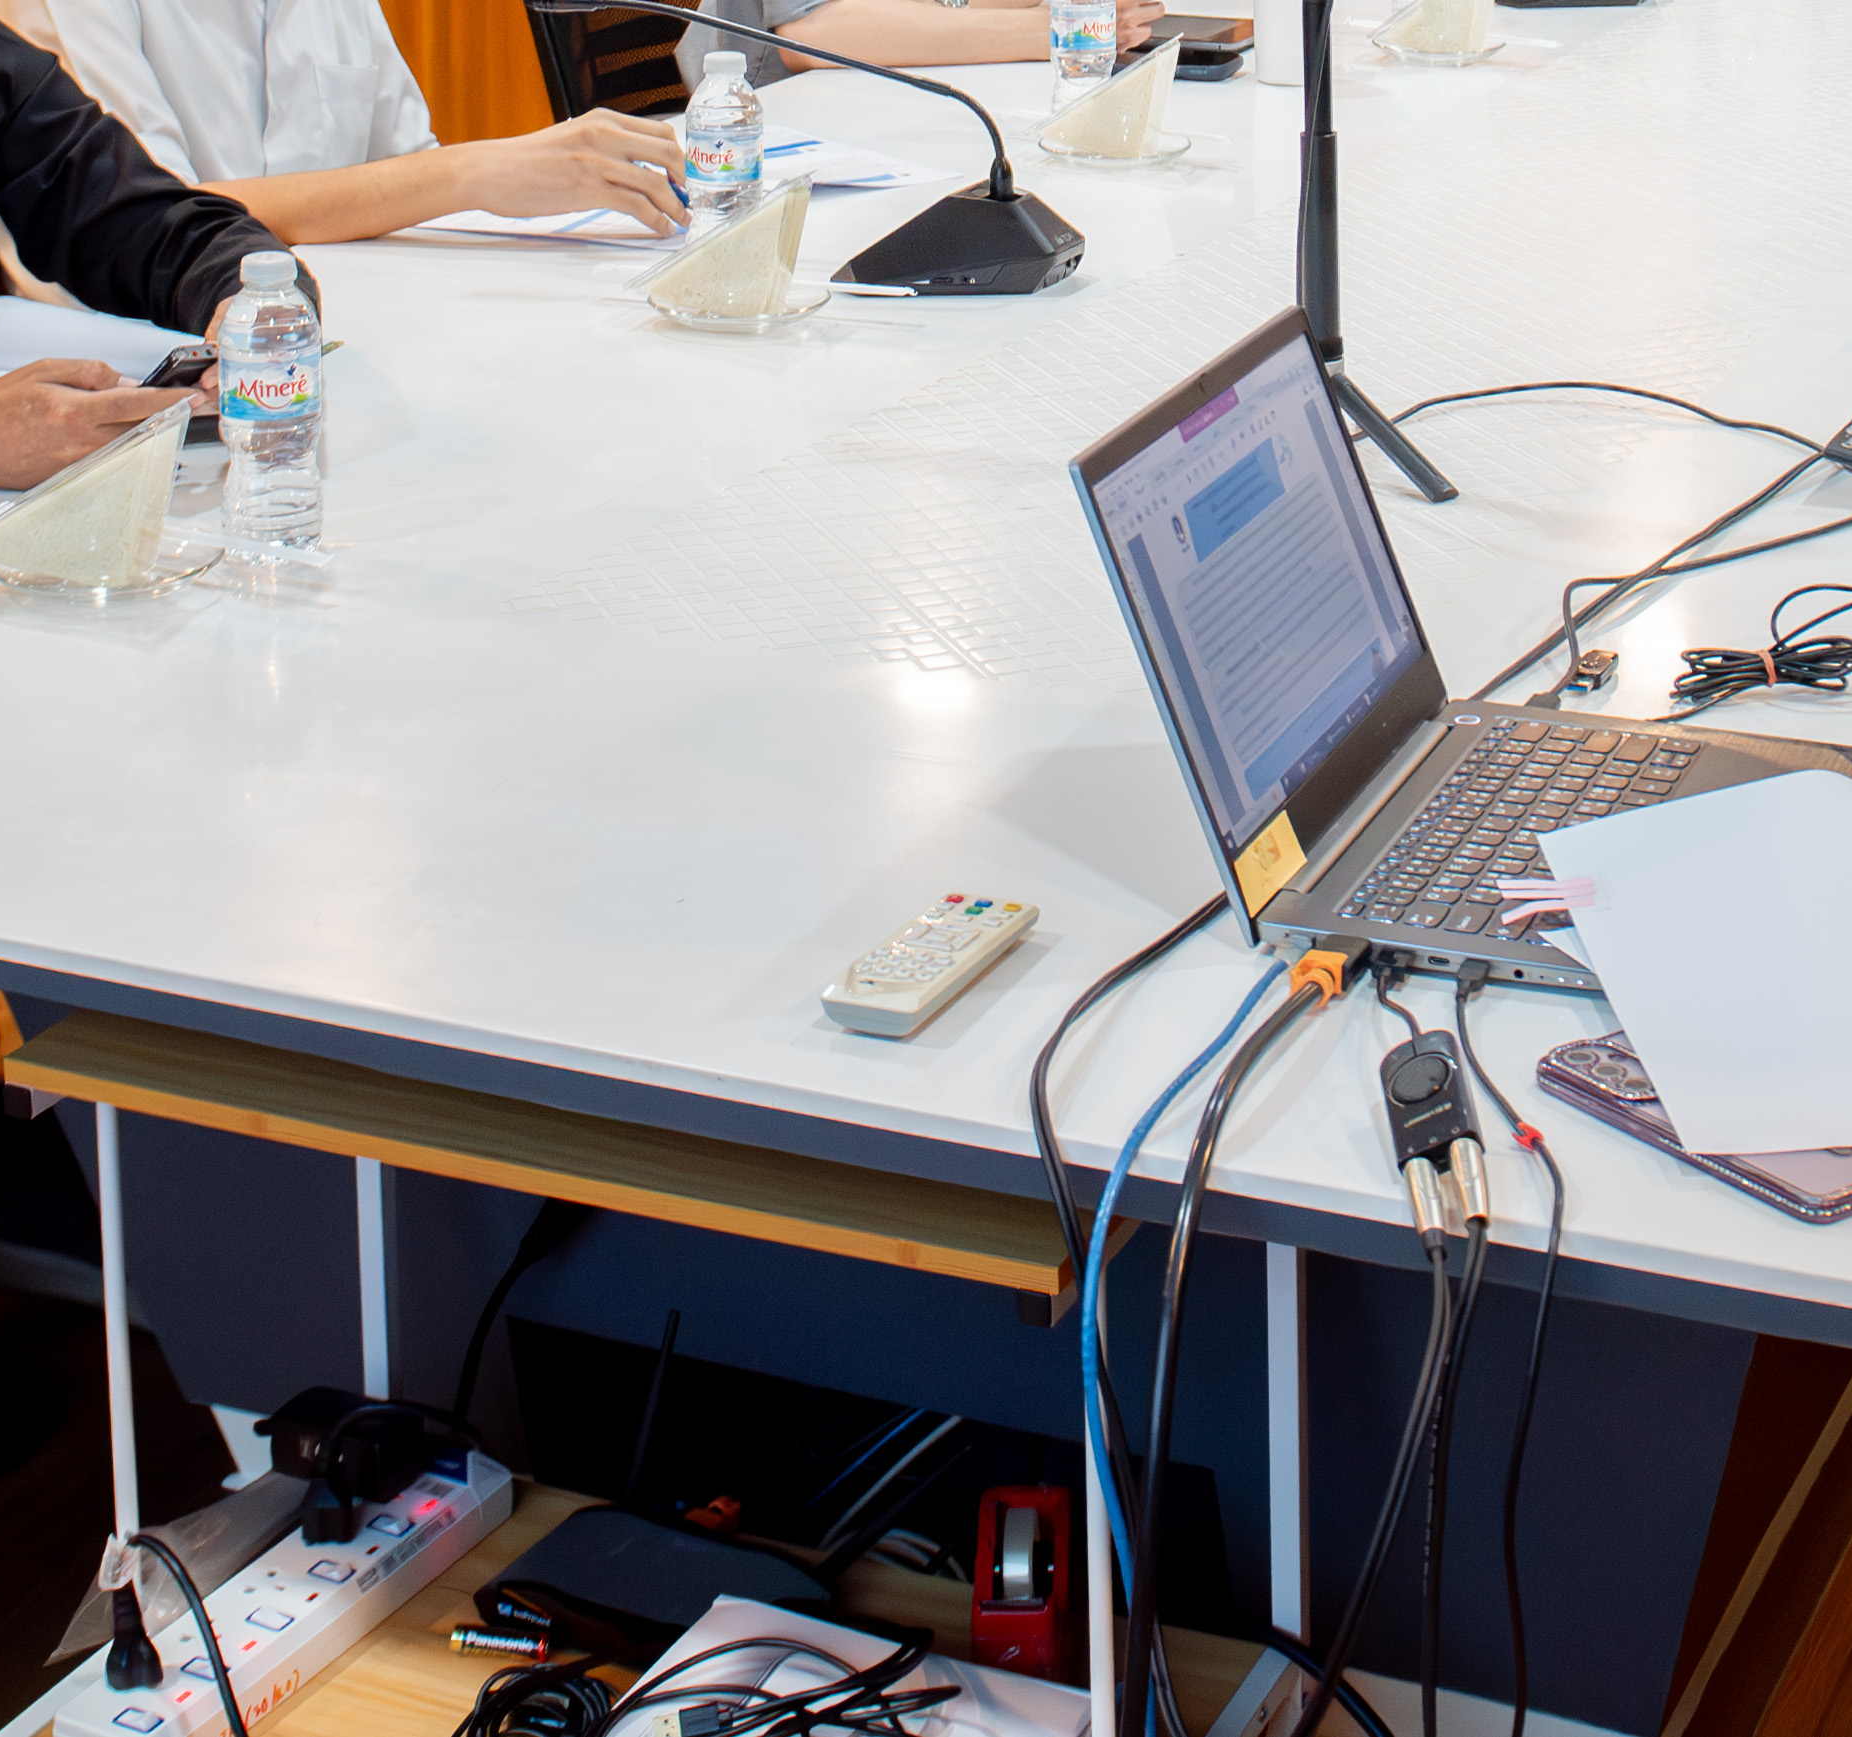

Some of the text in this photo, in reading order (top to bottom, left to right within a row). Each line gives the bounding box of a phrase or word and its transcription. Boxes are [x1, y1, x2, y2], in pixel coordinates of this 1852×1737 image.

[688, 146, 734, 168] Mineré
[238, 373, 309, 402] Mineré
[466, 1630, 535, 1653] Panasonic
